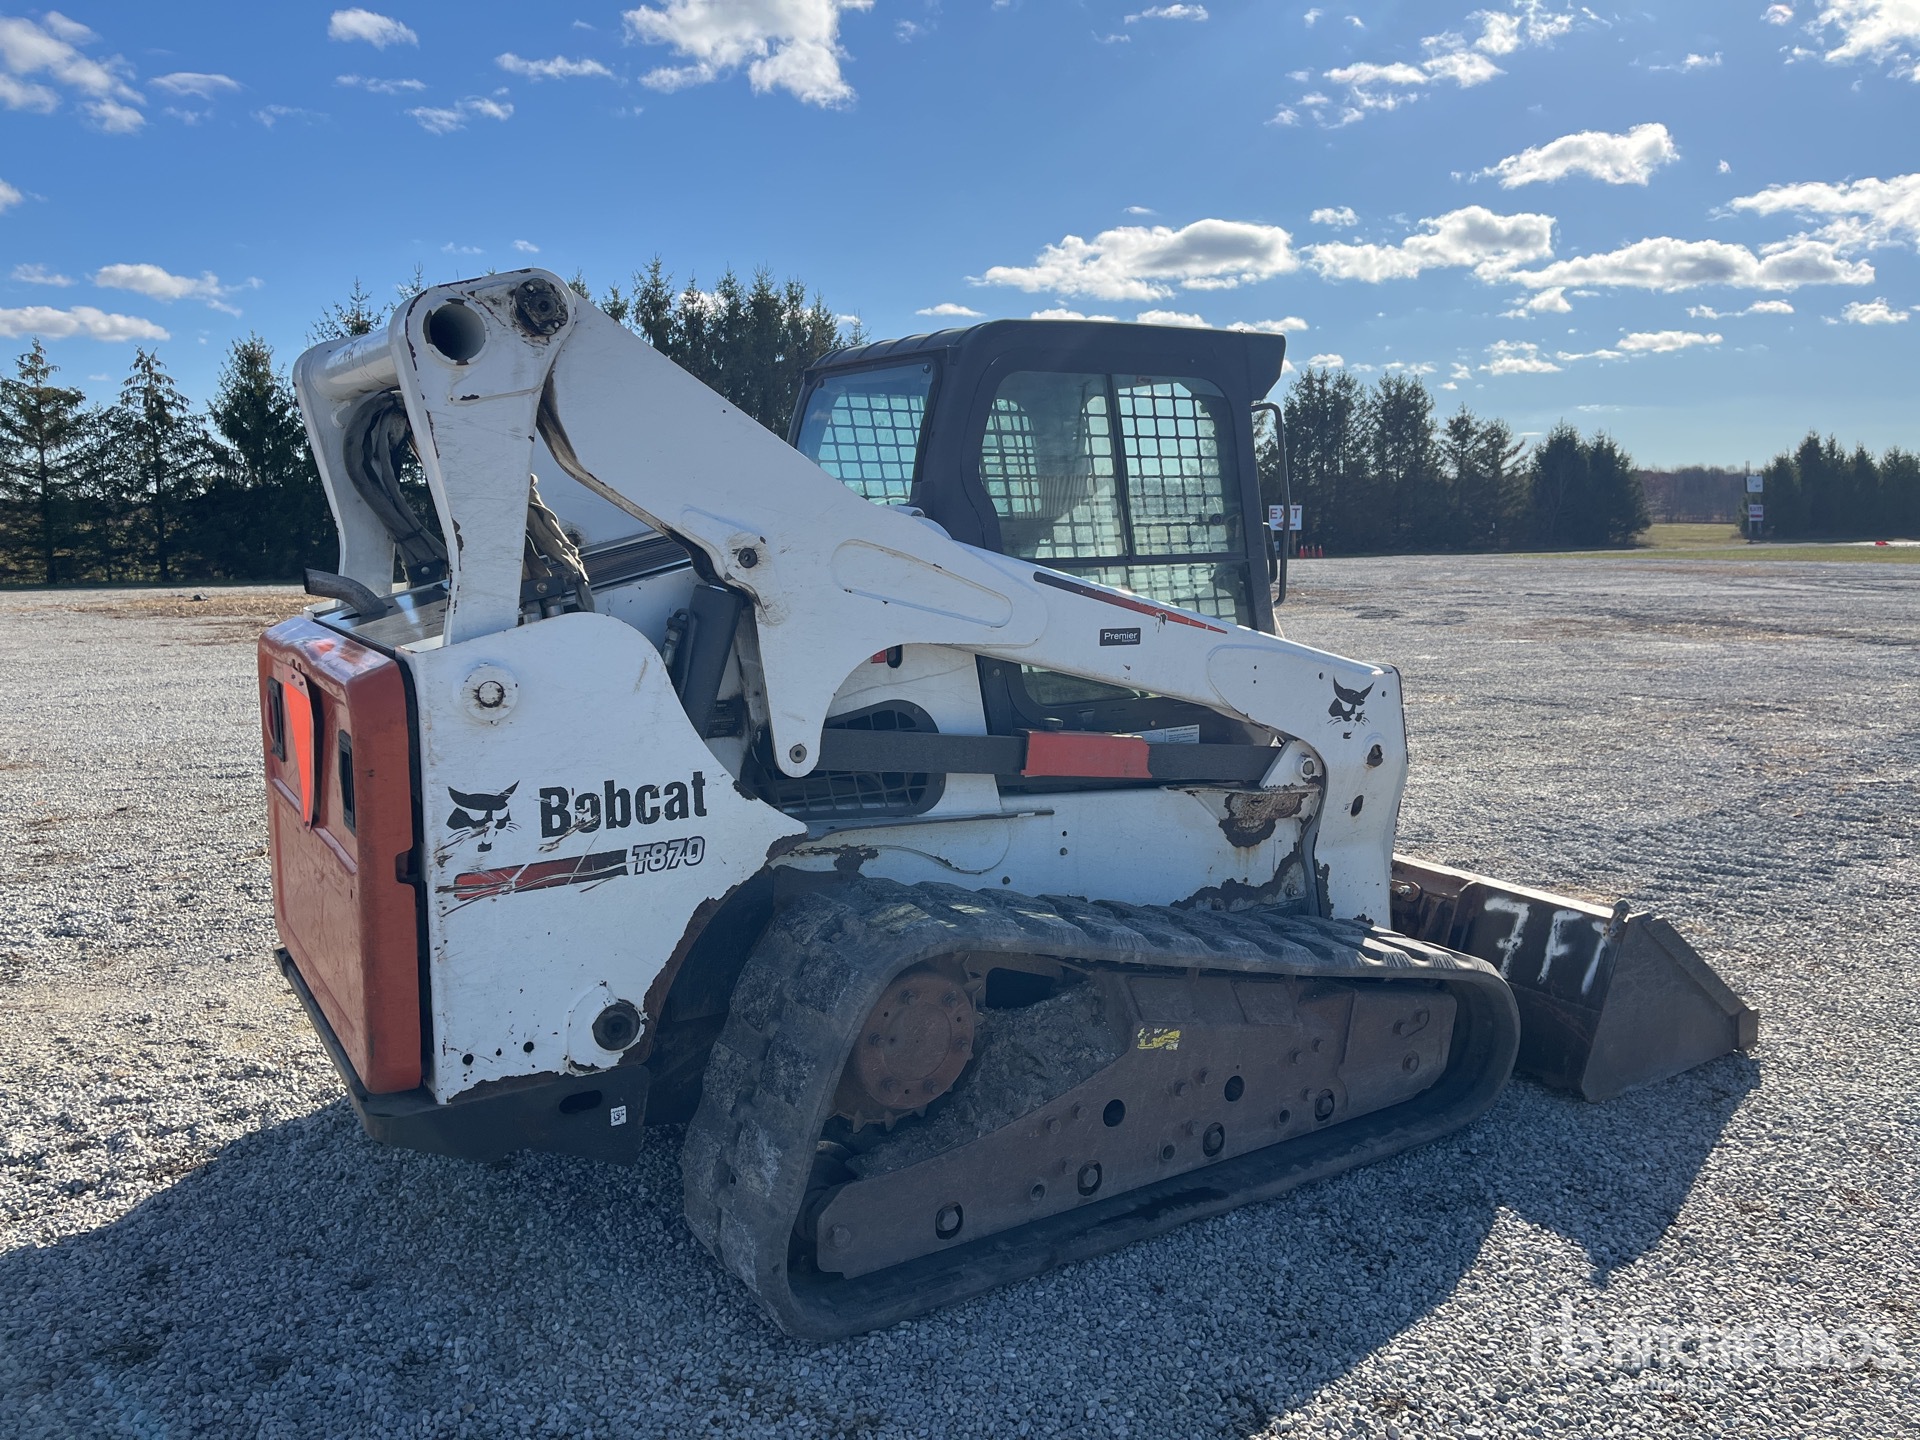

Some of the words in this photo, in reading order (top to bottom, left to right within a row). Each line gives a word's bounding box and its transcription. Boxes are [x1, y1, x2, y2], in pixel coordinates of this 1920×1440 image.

[1269, 508, 1301, 519] EXT
[1104, 632, 1138, 640] Premier
[539, 771, 707, 838] Bobcat
[632, 836, 706, 875] T870
